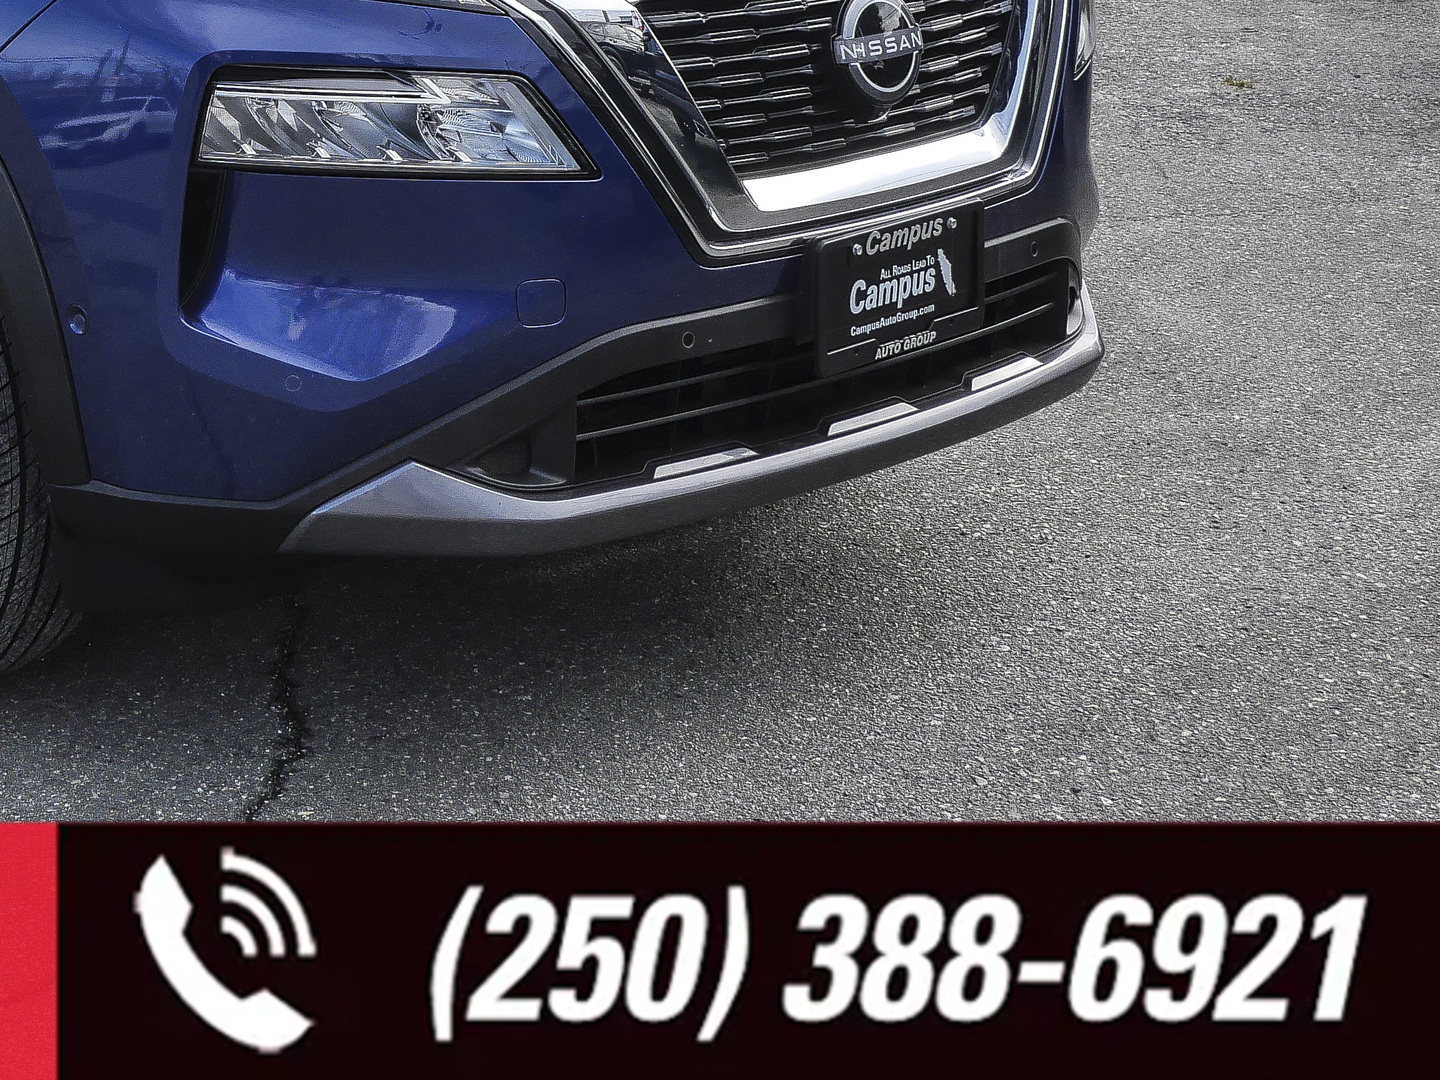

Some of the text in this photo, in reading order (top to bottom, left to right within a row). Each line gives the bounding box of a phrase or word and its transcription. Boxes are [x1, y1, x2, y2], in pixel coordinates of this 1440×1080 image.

[840, 31, 922, 60] NISSAN
[865, 218, 943, 255] Campus
[849, 268, 935, 314] Campus
[850, 304, 935, 336] CampusAutoGroup.com
[875, 331, 936, 360] AUTO GROUP
